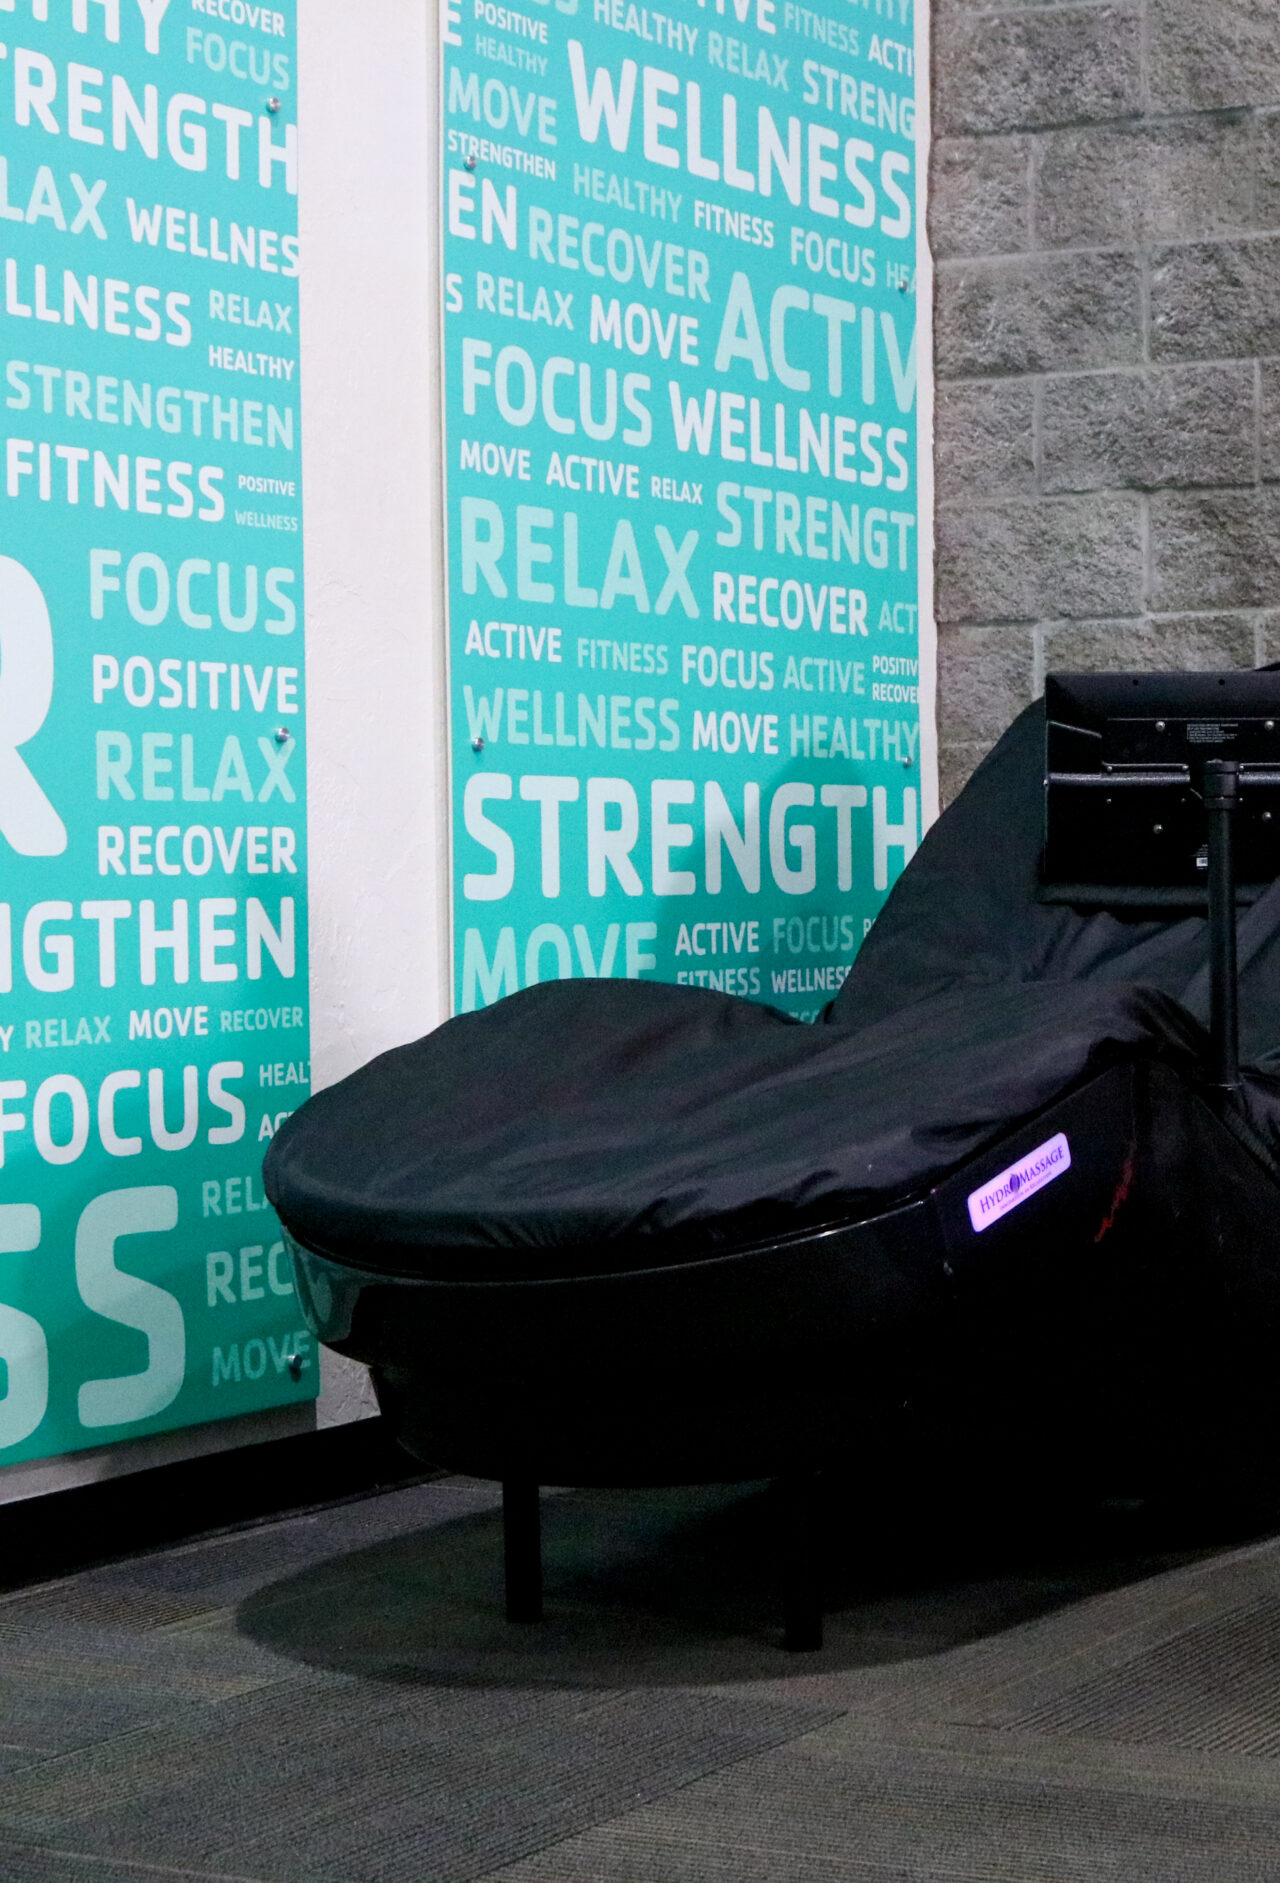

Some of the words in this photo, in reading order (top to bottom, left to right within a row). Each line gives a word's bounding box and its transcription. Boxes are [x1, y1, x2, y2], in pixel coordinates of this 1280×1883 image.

[192, 0, 285, 37] RECOVER
[474, 0, 548, 44] POSITIVE
[476, 34, 548, 76] HEALTHY
[784, 2, 859, 56] FITNESS
[868, 34, 913, 77] ACTI
[187, 27, 289, 90] FOCUS
[594, 0, 699, 56] HEALTHY
[708, 31, 789, 91] RELAX
[803, 60, 914, 142] STRENG
[0, 42, 298, 196] RENGTH
[448, 67, 557, 145] MOVE
[567, 39, 911, 239] WELLNESS
[448, 129, 556, 180] STRENGTHEN
[126, 198, 298, 278] WELLNES
[448, 169, 517, 250] EN
[529, 206, 711, 303] RECOVER
[574, 163, 682, 223] HEALTHY
[694, 200, 774, 248] FITNESS
[791, 227, 876, 287] FOCUS
[6, 258, 192, 347] LLNESS
[210, 290, 292, 334] RELAX
[446, 273, 463, 313] S
[477, 271, 574, 330] RELAX
[590, 294, 699, 366] MOVE
[209, 345, 295, 381] HEALTHY
[6, 360, 293, 450] STRENGTHEN
[462, 338, 652, 447] FOCUS
[669, 381, 911, 493] WELLNESS
[7, 438, 225, 522] FITNESS
[238, 475, 295, 497] POSITIVE
[460, 439, 531, 480] MOVE
[546, 452, 640, 498] ACTIVE
[651, 476, 703, 504] RELAX
[235, 510, 298, 532] WELLNESS
[461, 496, 700, 618] RELAX
[717, 481, 917, 571] STRENGT
[90, 549, 296, 635] FOCUS
[713, 572, 869, 636] RECOVER
[878, 601, 917, 634] ACT
[93, 654, 299, 714] POSITIVE
[465, 620, 562, 662] ACTIVE
[578, 638, 668, 674] FITNESS
[682, 645, 774, 690] FOCUS
[783, 656, 865, 695] ACTIVE
[463, 684, 680, 752] WELLNESS
[692, 711, 779, 755] MOVE
[790, 714, 919, 762] HEALTHY
[96, 731, 296, 803] RELAX
[98, 825, 298, 876] RECOVER
[463, 772, 917, 901] STRENGTH
[463, 922, 657, 1010] MOVE
[675, 921, 759, 955] ACTIVE
[774, 916, 853, 953] FOCUS
[26, 1016, 111, 1048] RELAX
[129, 1006, 209, 1040] MOVE
[220, 1006, 303, 1032] RECOVER
[260, 1062, 309, 1086] HEAL
[0, 1061, 246, 1168] FOCUS
[212, 1331, 310, 1386] MOVE
